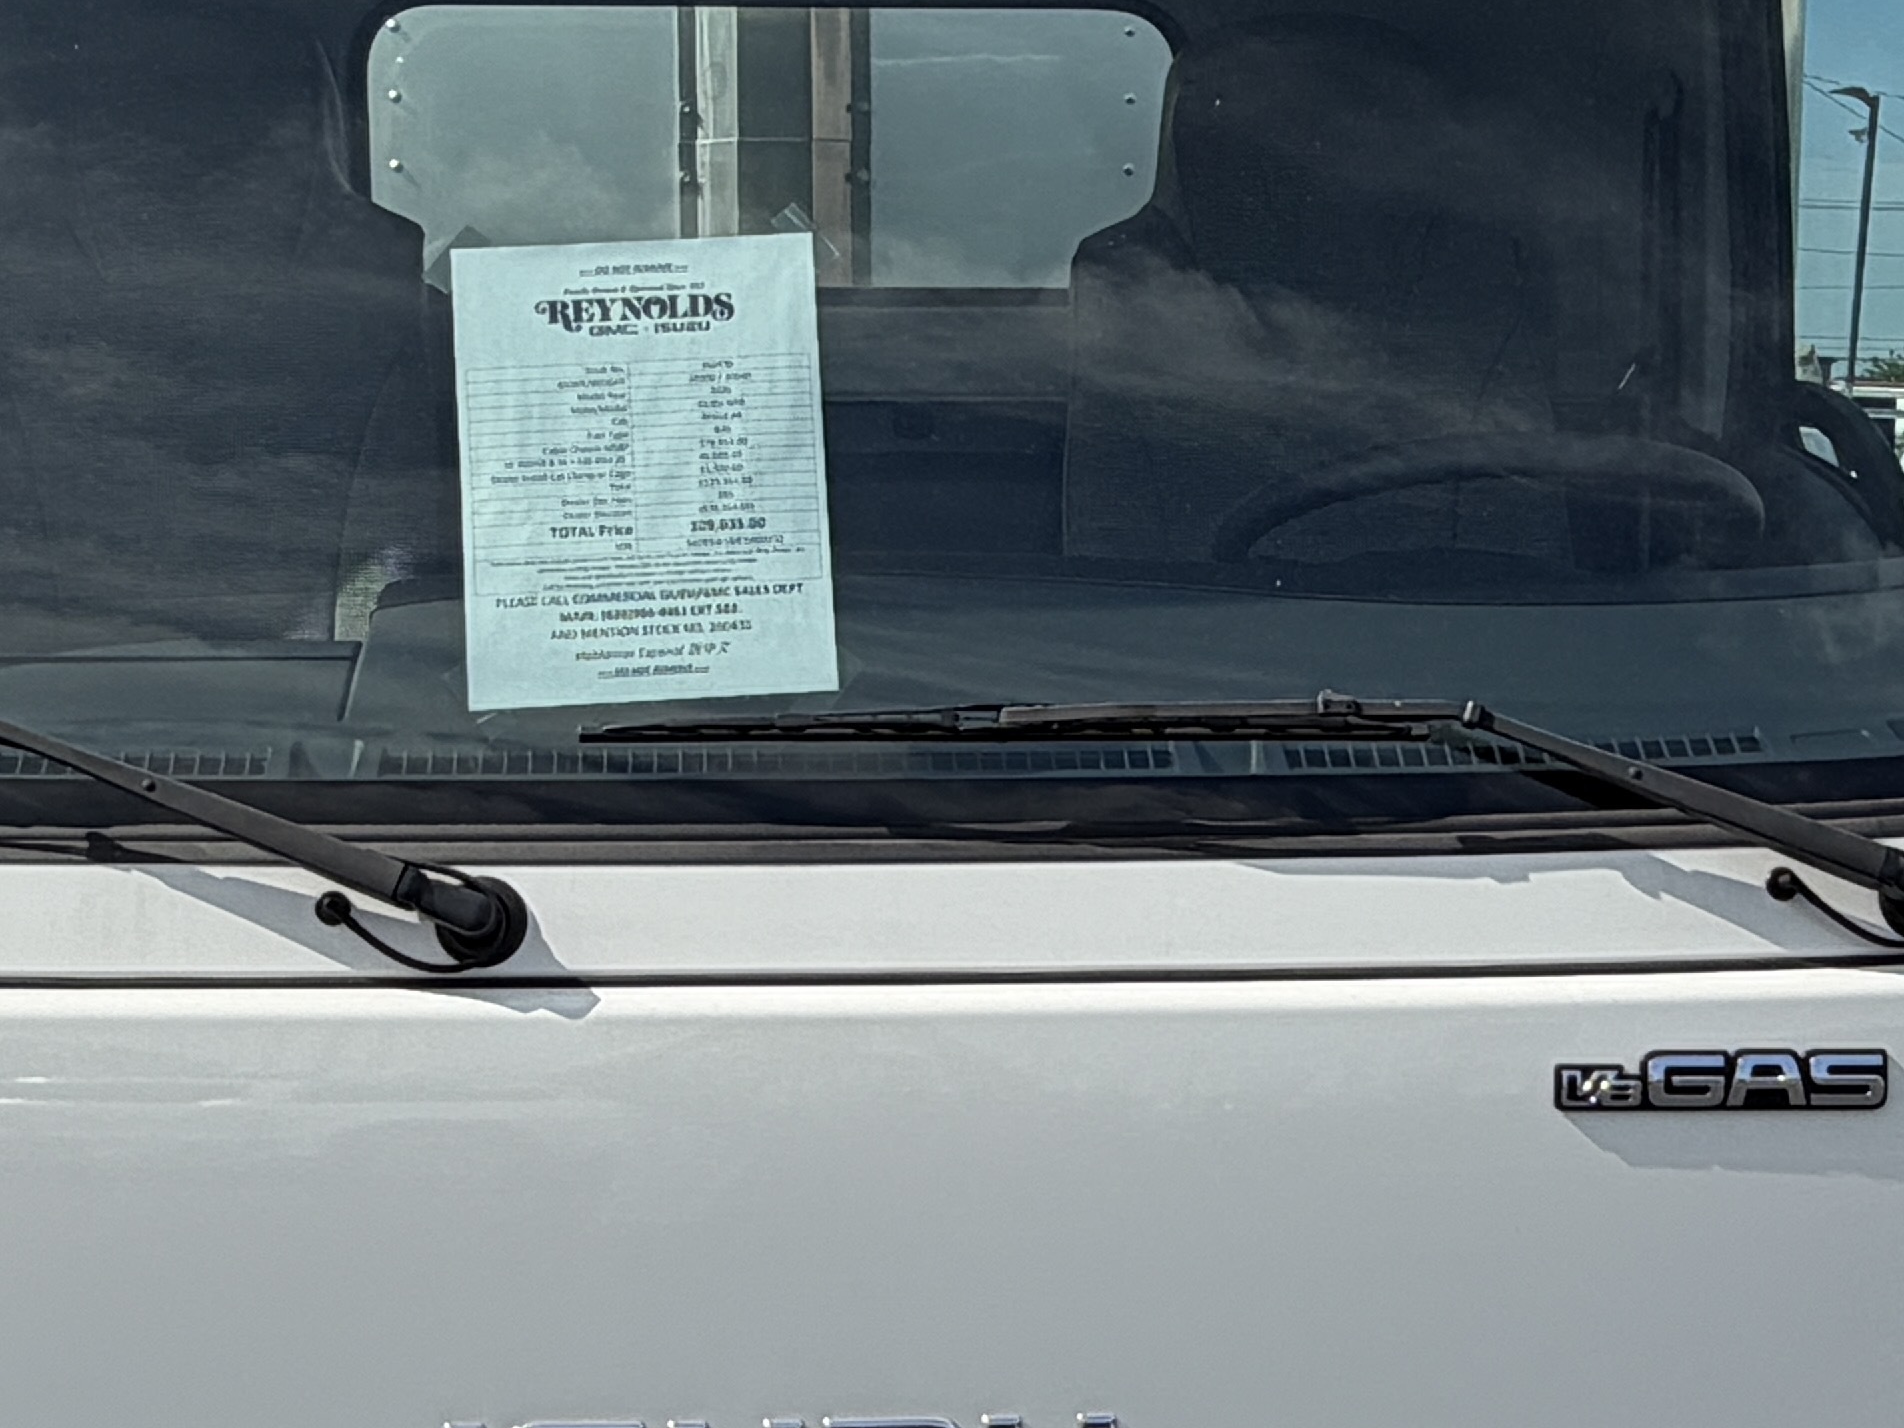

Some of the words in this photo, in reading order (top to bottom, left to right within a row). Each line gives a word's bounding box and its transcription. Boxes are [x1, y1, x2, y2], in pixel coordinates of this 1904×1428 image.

[534, 291, 736, 334] REYNOLDS
[550, 526, 595, 539] TOTAL
[1645, 1051, 1886, 1109] GAS
